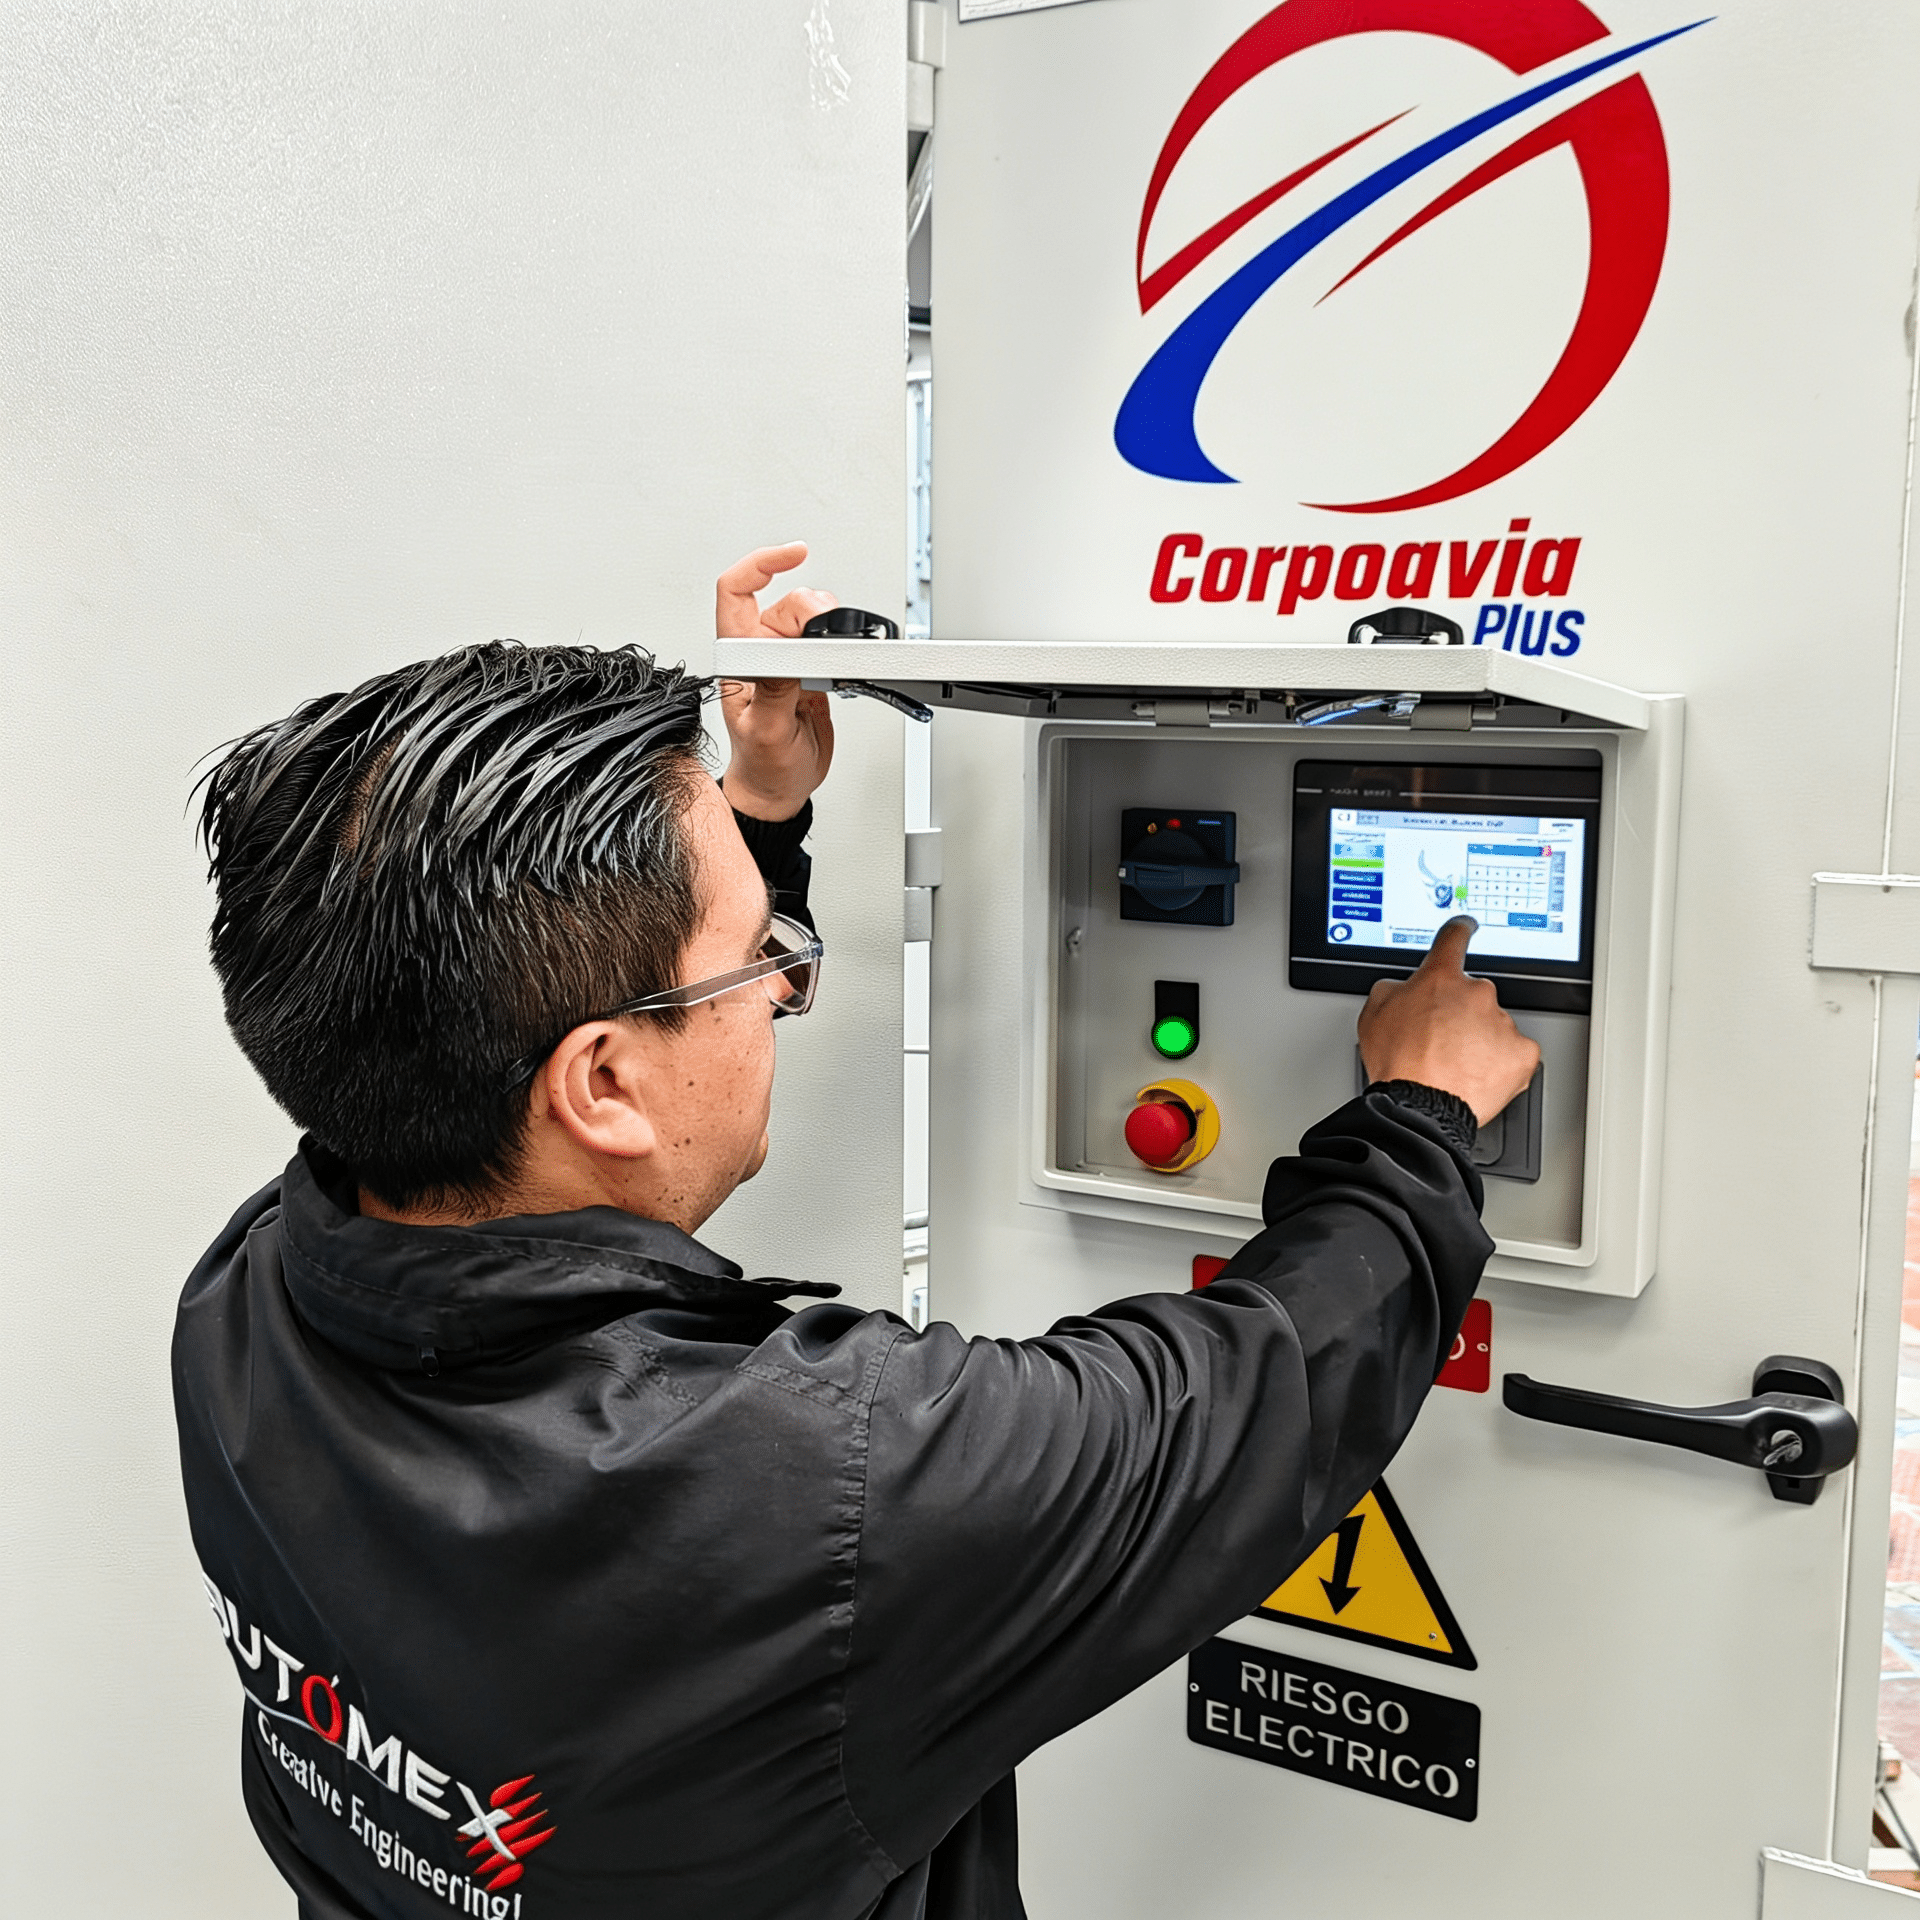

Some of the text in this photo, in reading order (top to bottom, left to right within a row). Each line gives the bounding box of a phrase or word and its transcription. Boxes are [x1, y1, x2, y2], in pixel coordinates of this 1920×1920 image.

[1149, 517, 1582, 615] Corpoavia
[1473, 603, 1585, 657] Plus
[1240, 1660, 1410, 1735] RIESGO
[1205, 1698, 1460, 1800] ELECTRICO
